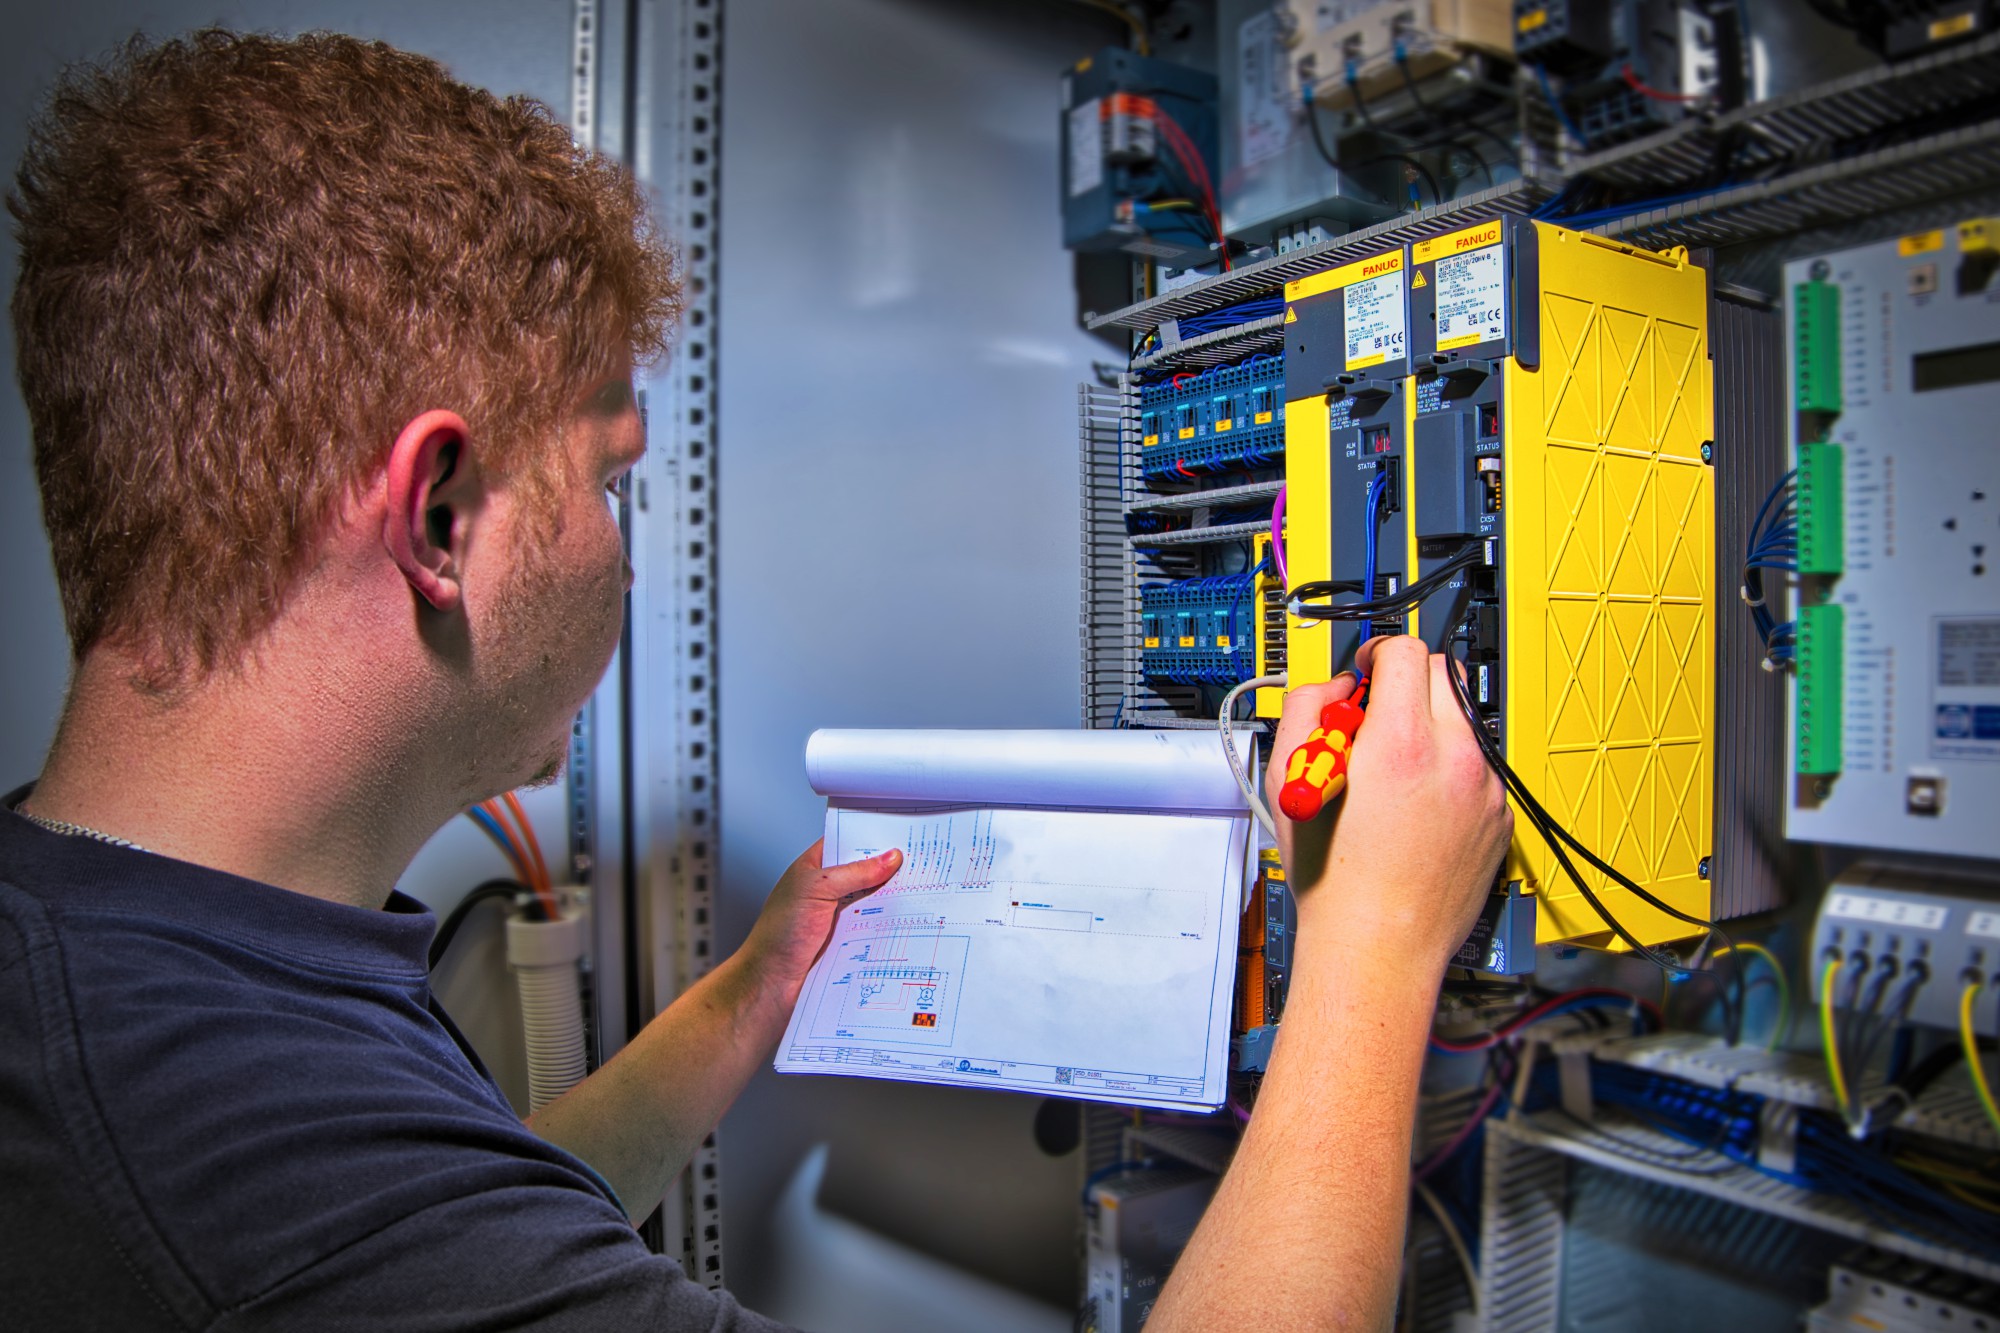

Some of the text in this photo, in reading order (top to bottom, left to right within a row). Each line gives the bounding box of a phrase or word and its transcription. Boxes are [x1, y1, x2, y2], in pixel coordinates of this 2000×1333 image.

[1456, 230, 1496, 249] FANUC
[1363, 258, 1398, 276] FANUC
[1417, 379, 1444, 391] WARNING
[1477, 441, 1500, 452] STATUS
[1357, 461, 1376, 471] STATUS
